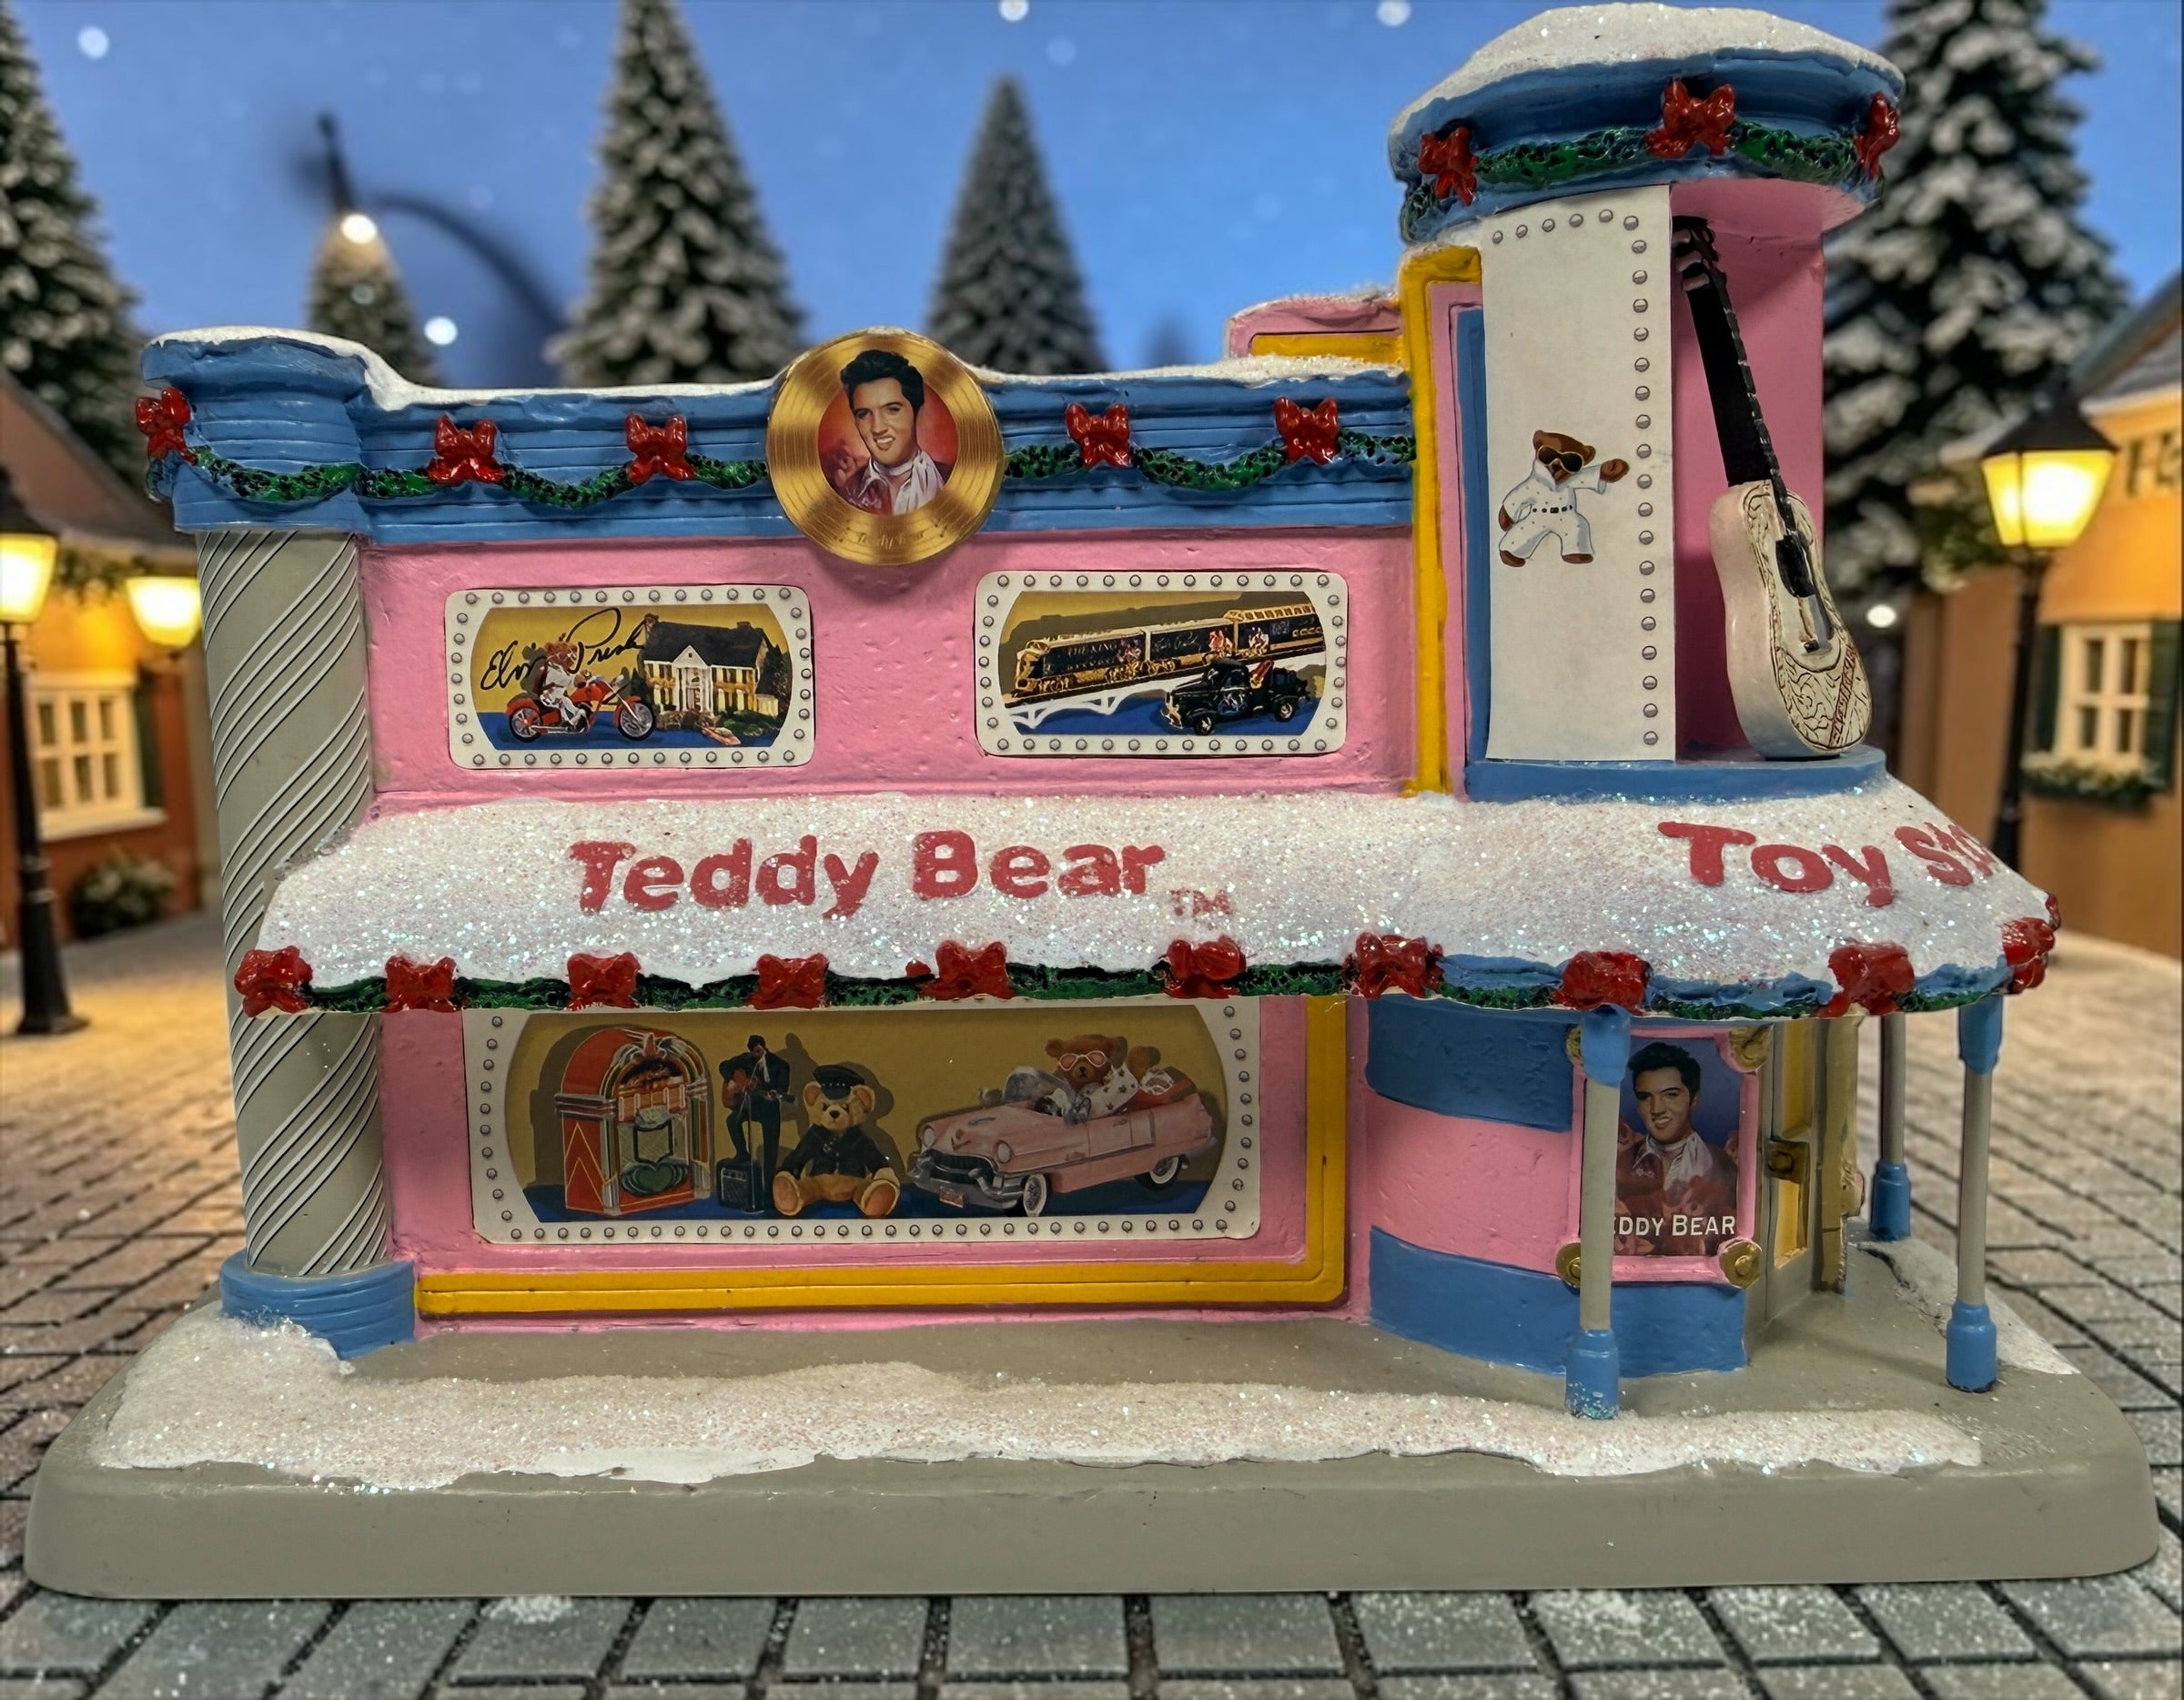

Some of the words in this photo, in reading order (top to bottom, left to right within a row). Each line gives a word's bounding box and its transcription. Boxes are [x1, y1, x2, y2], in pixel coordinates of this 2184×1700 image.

[569, 834, 880, 919] Teddy
[913, 830, 1166, 900] Bear
[1169, 888, 1232, 917] TM
[1658, 822, 1896, 908] Toy
[1613, 1215, 1663, 1237] DDY
[1672, 1214, 1735, 1237] BEAR
